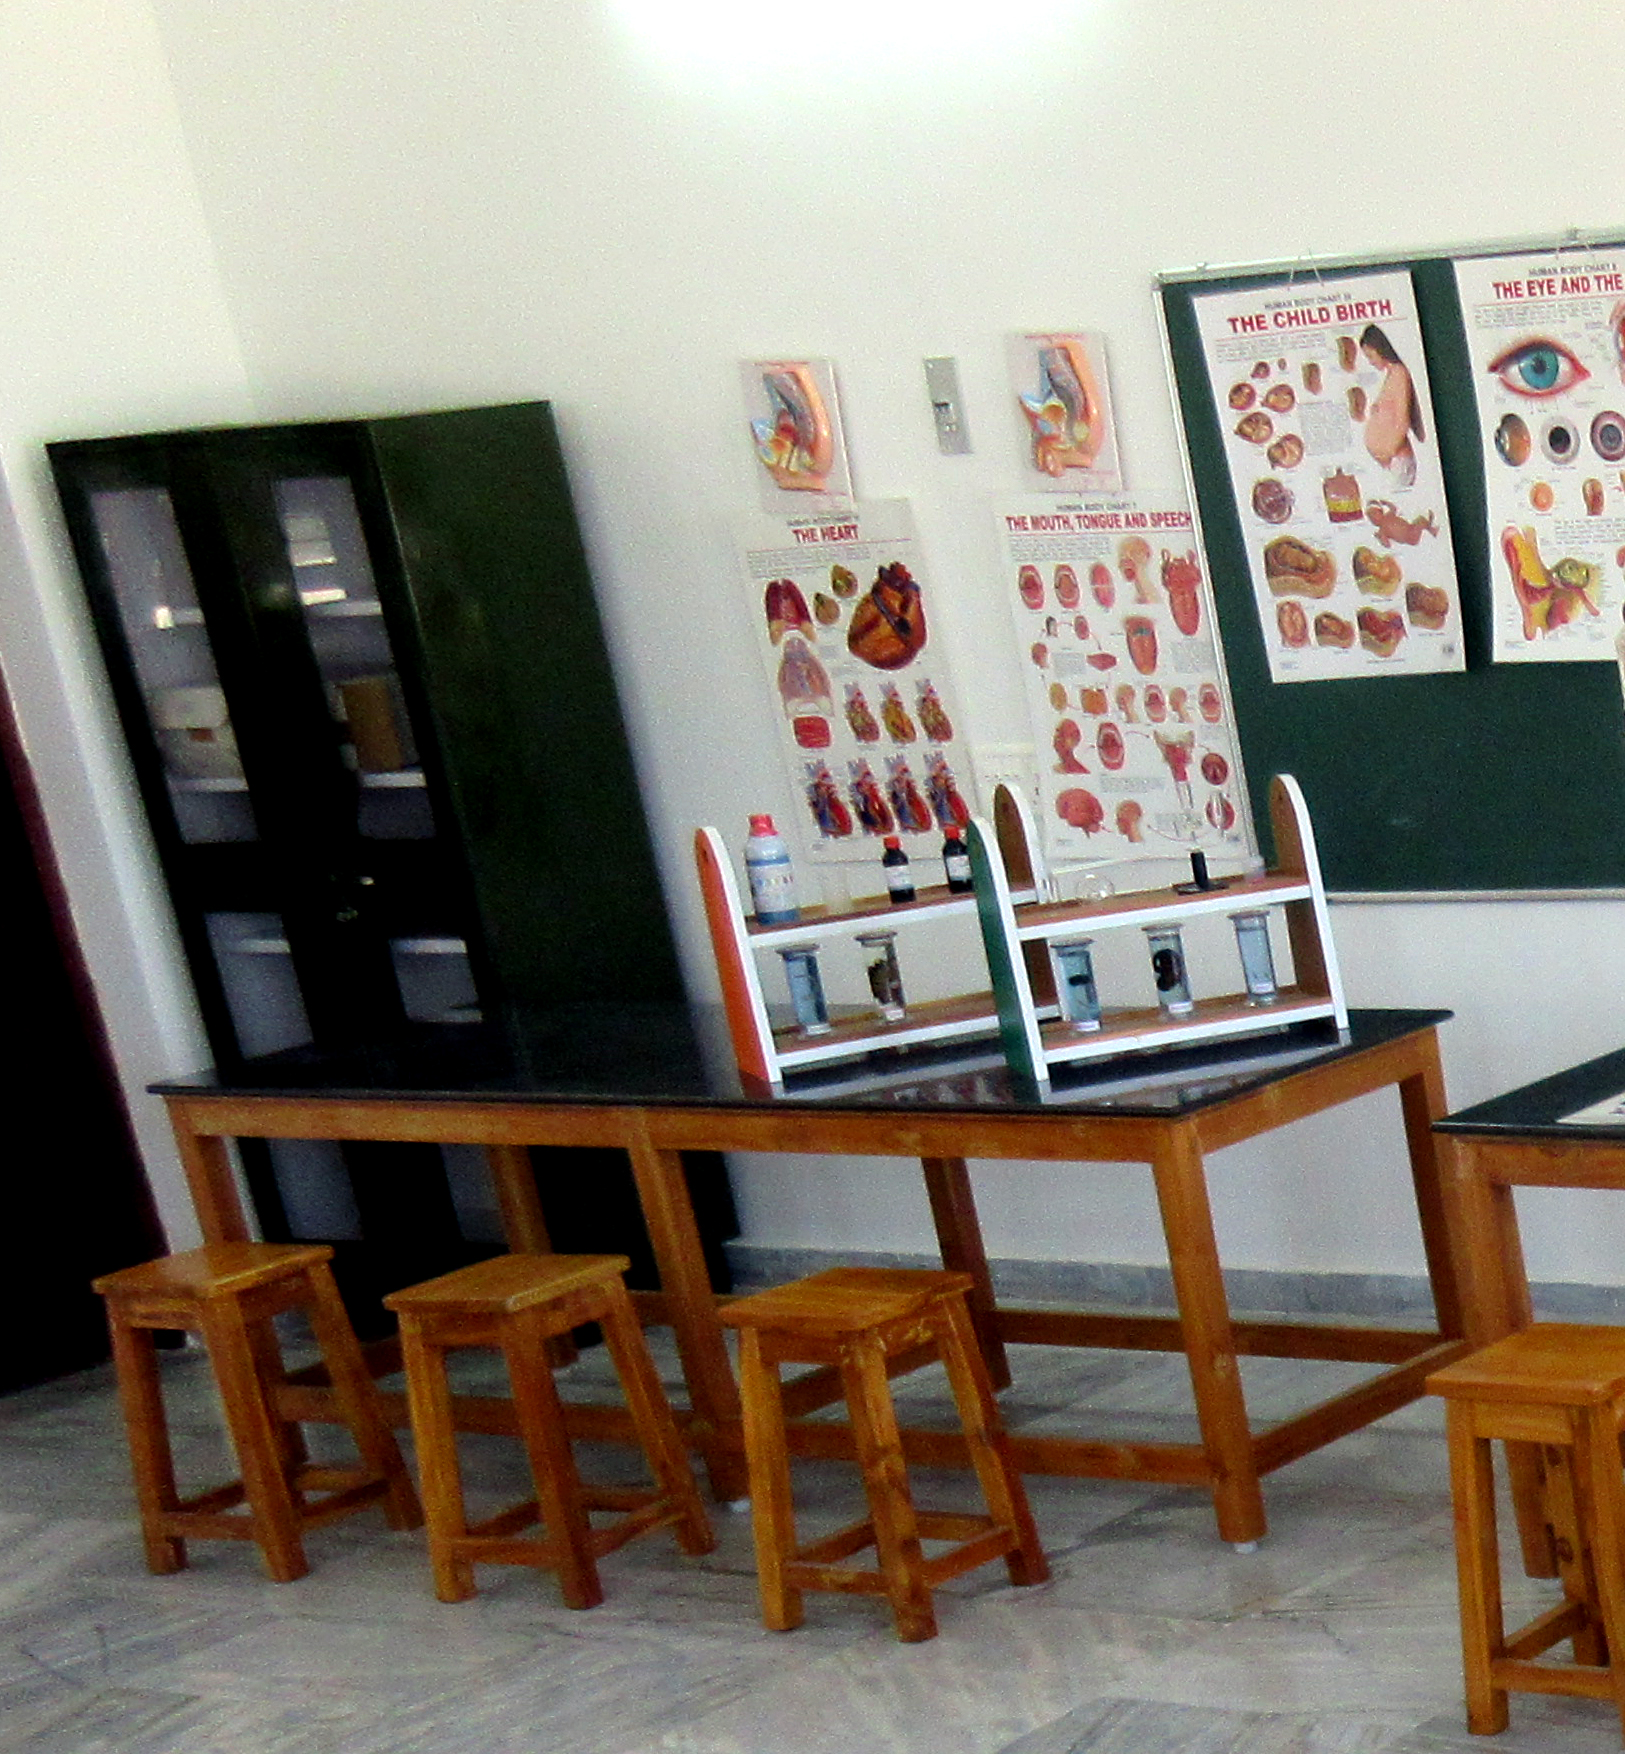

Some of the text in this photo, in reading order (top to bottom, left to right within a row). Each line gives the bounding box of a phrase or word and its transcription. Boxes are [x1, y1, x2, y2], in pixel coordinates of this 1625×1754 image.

[1493, 280, 1524, 299] THE
[1527, 278, 1557, 297] EYE
[1561, 275, 1591, 294] AND
[1594, 273, 1623, 291] THE
[1227, 299, 1392, 333] THE CHILD BIRTH
[1005, 511, 1192, 532] THE MOUTH, TONGUE AND SPEECH
[792, 524, 859, 544] THE HEART
